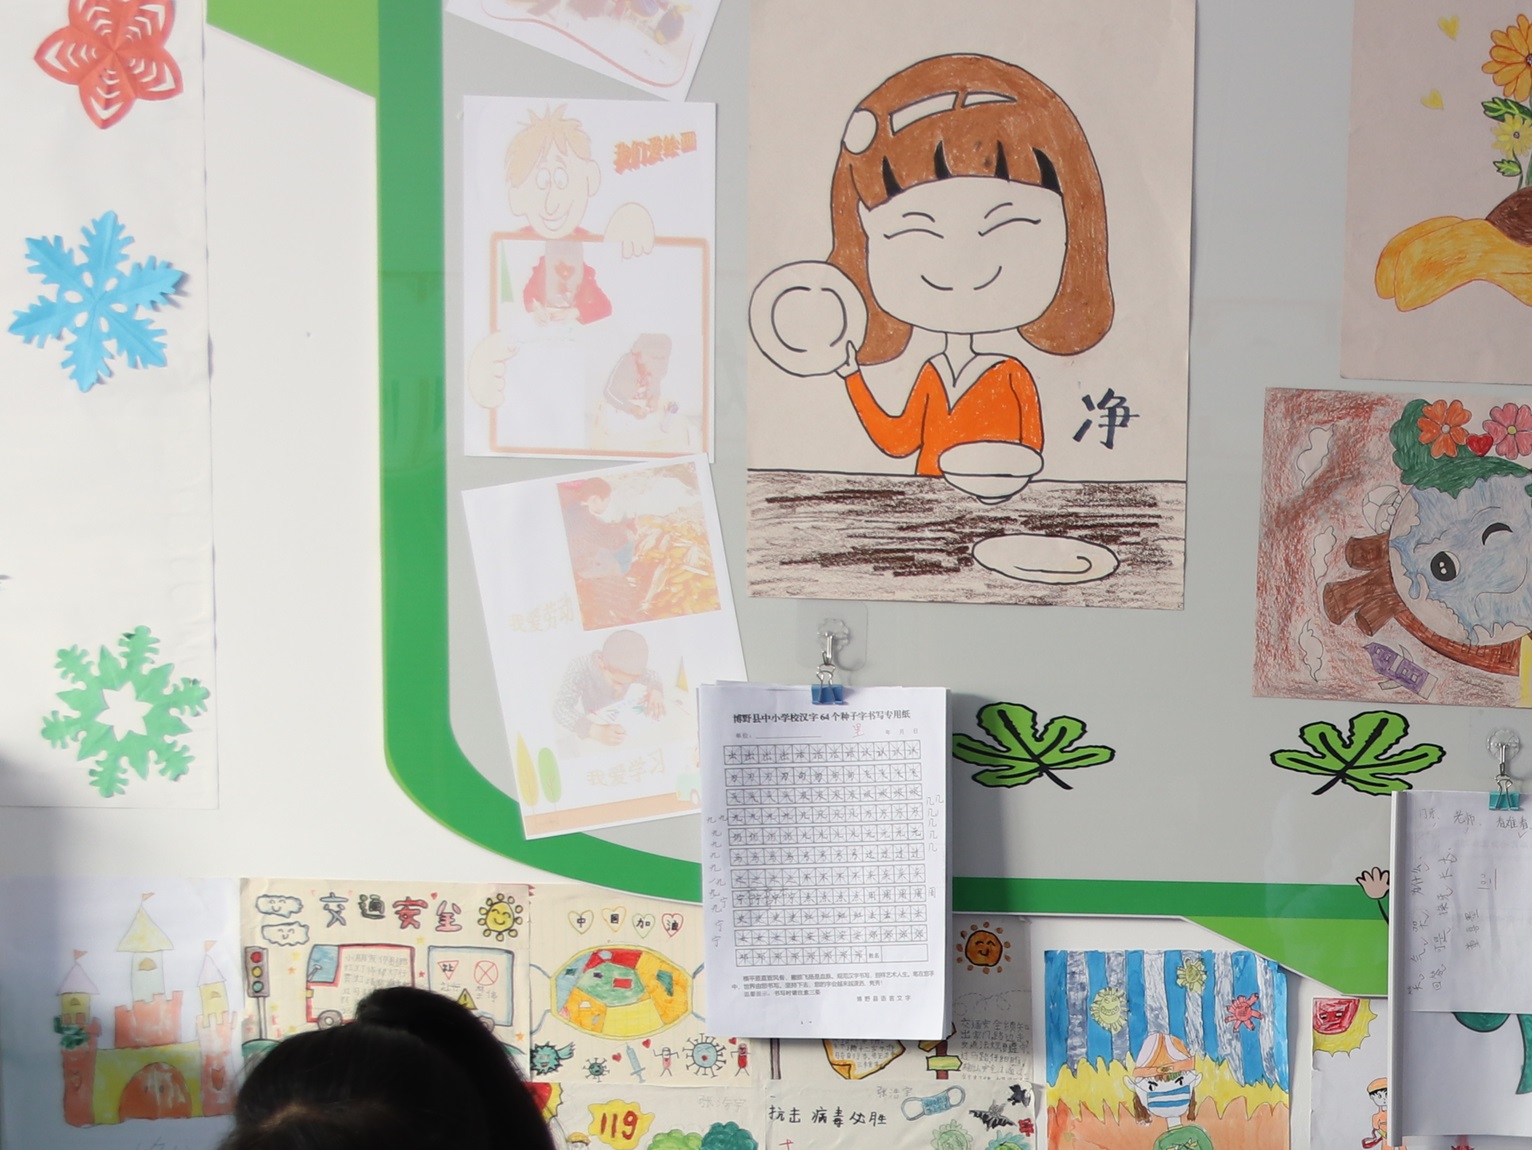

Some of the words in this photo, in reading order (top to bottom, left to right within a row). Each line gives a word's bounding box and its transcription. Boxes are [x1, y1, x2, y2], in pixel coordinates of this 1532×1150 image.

[1072, 388, 1140, 449] 净
[319, 892, 463, 932] 交通安全
[600, 1110, 639, 1141] 119
